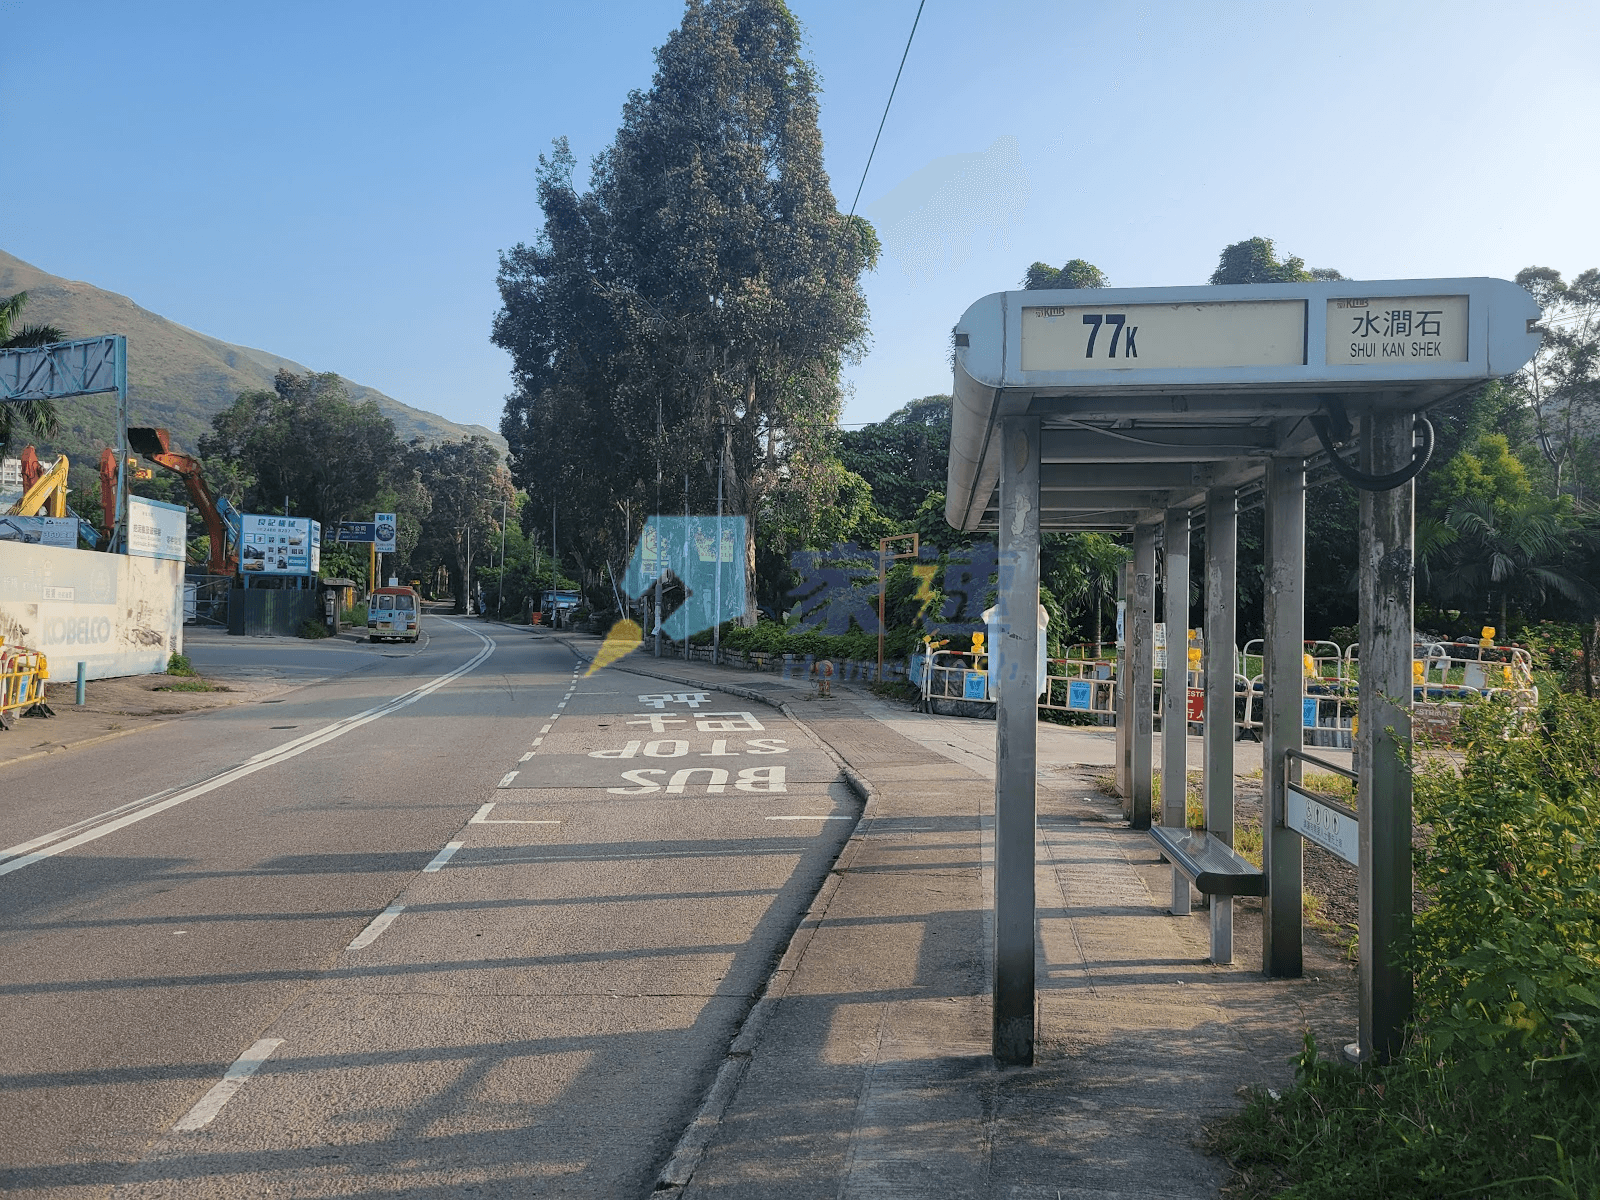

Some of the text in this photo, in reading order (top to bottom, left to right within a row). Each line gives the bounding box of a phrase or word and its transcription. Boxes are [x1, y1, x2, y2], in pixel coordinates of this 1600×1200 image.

[1082, 314, 1139, 358] 77K
[1351, 310, 1443, 337] 水澗石
[1349, 341, 1442, 357] SHUI KAN SHEK
[588, 738, 790, 759] STOP
[606, 765, 788, 795] BUS
